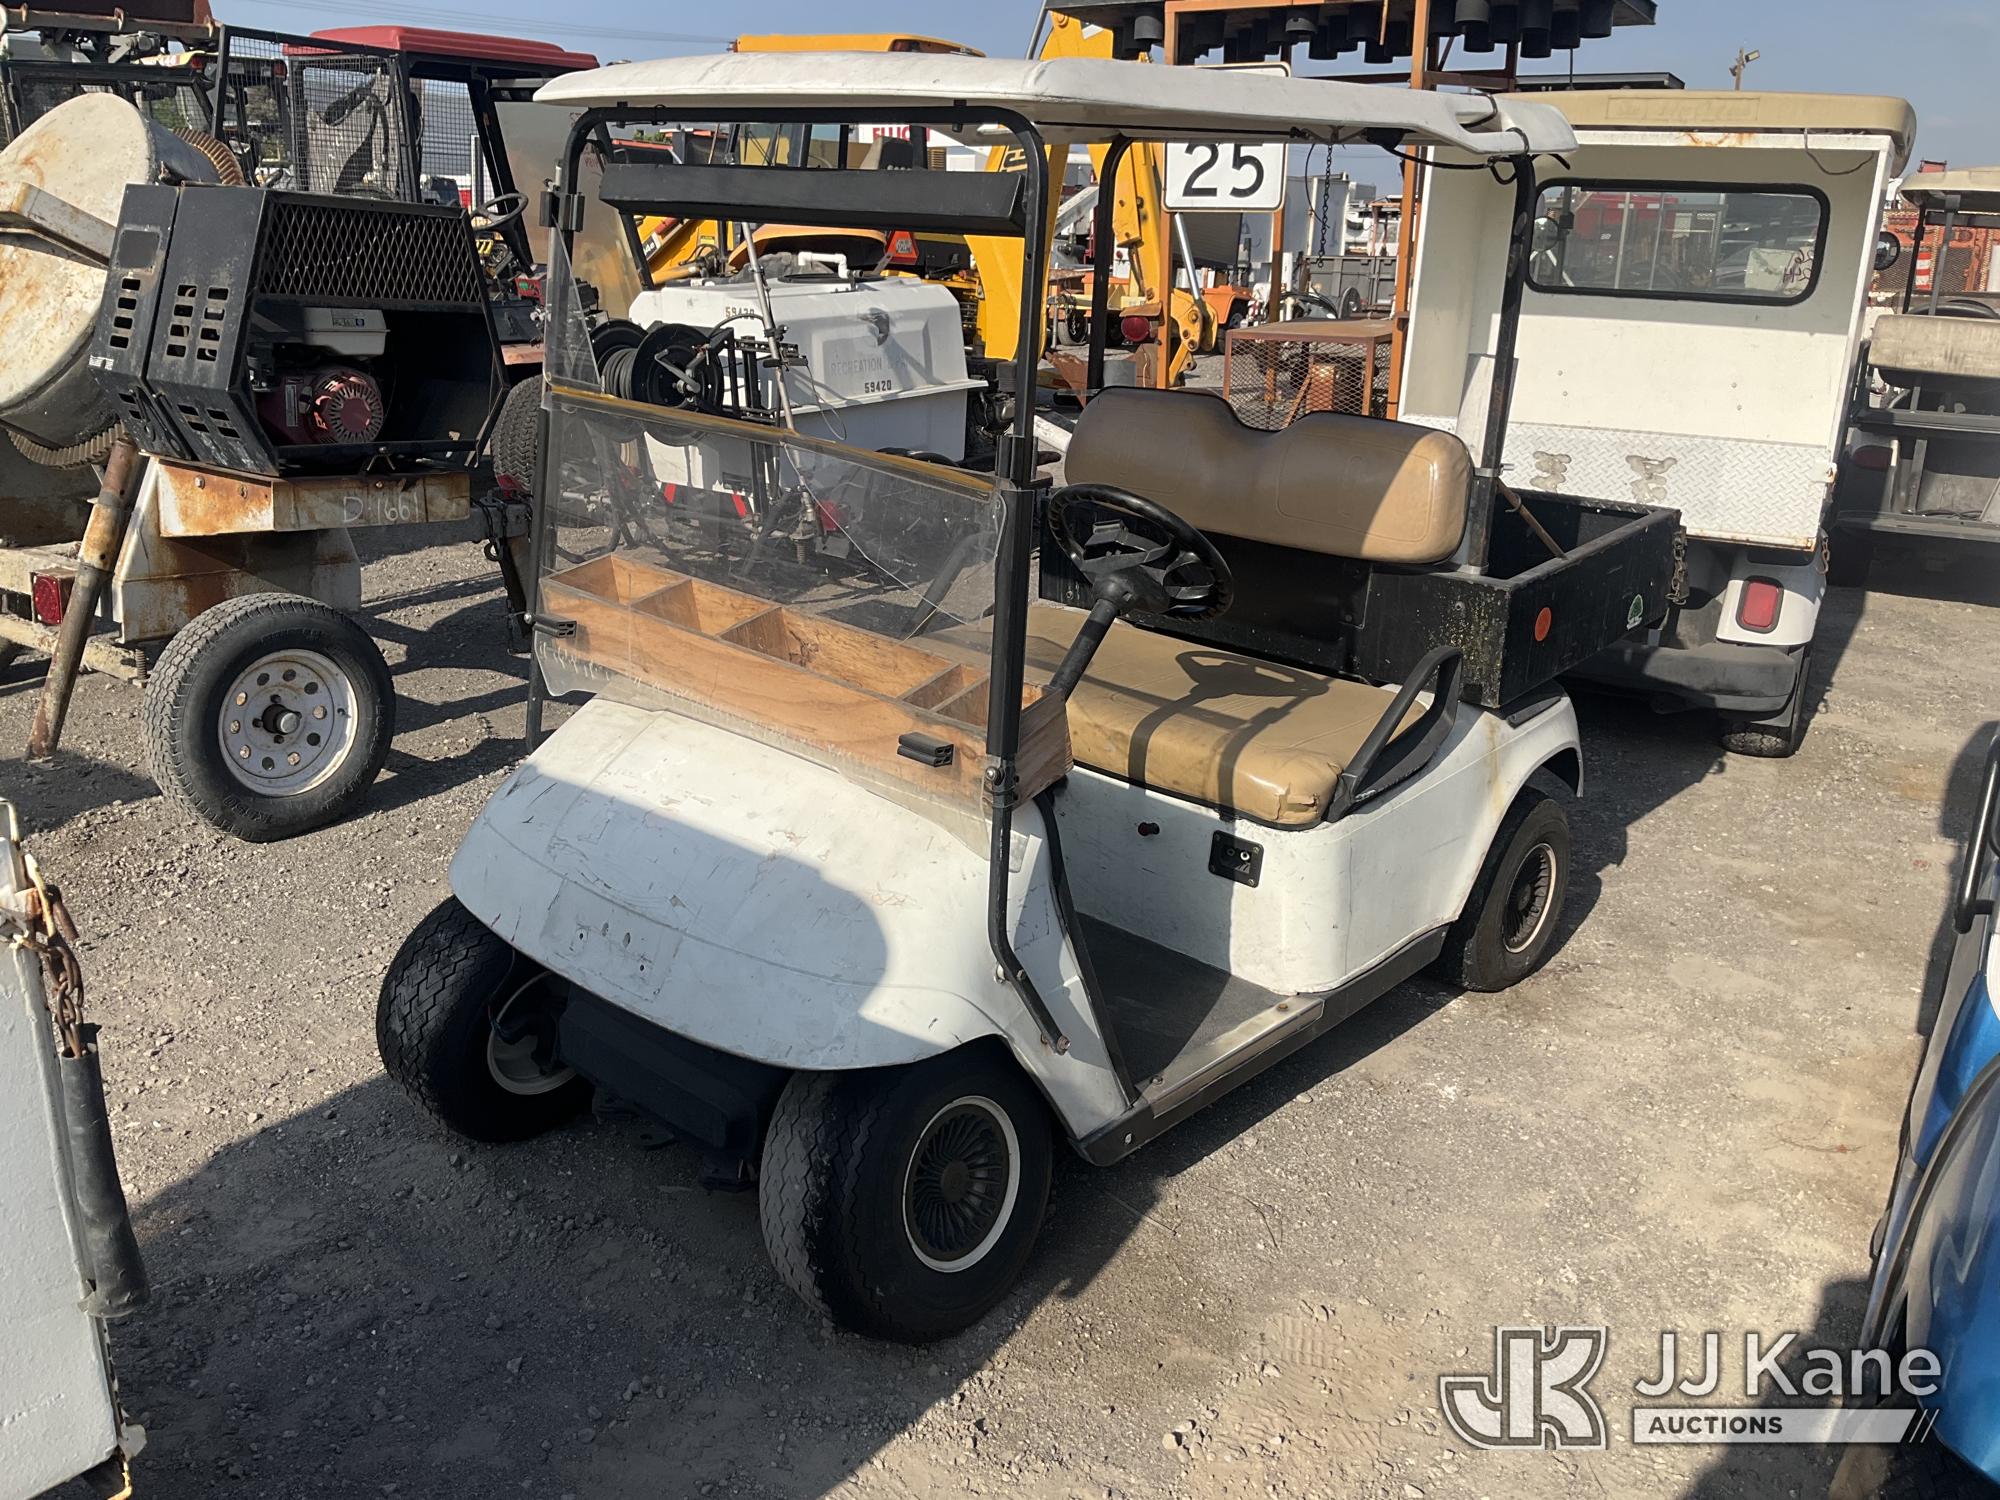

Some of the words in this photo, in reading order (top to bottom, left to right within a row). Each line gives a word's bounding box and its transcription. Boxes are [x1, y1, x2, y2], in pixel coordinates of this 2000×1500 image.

[1182, 143, 1264, 198] 25
[831, 358, 882, 377] RECREATION
[863, 379, 893, 394] 59420
